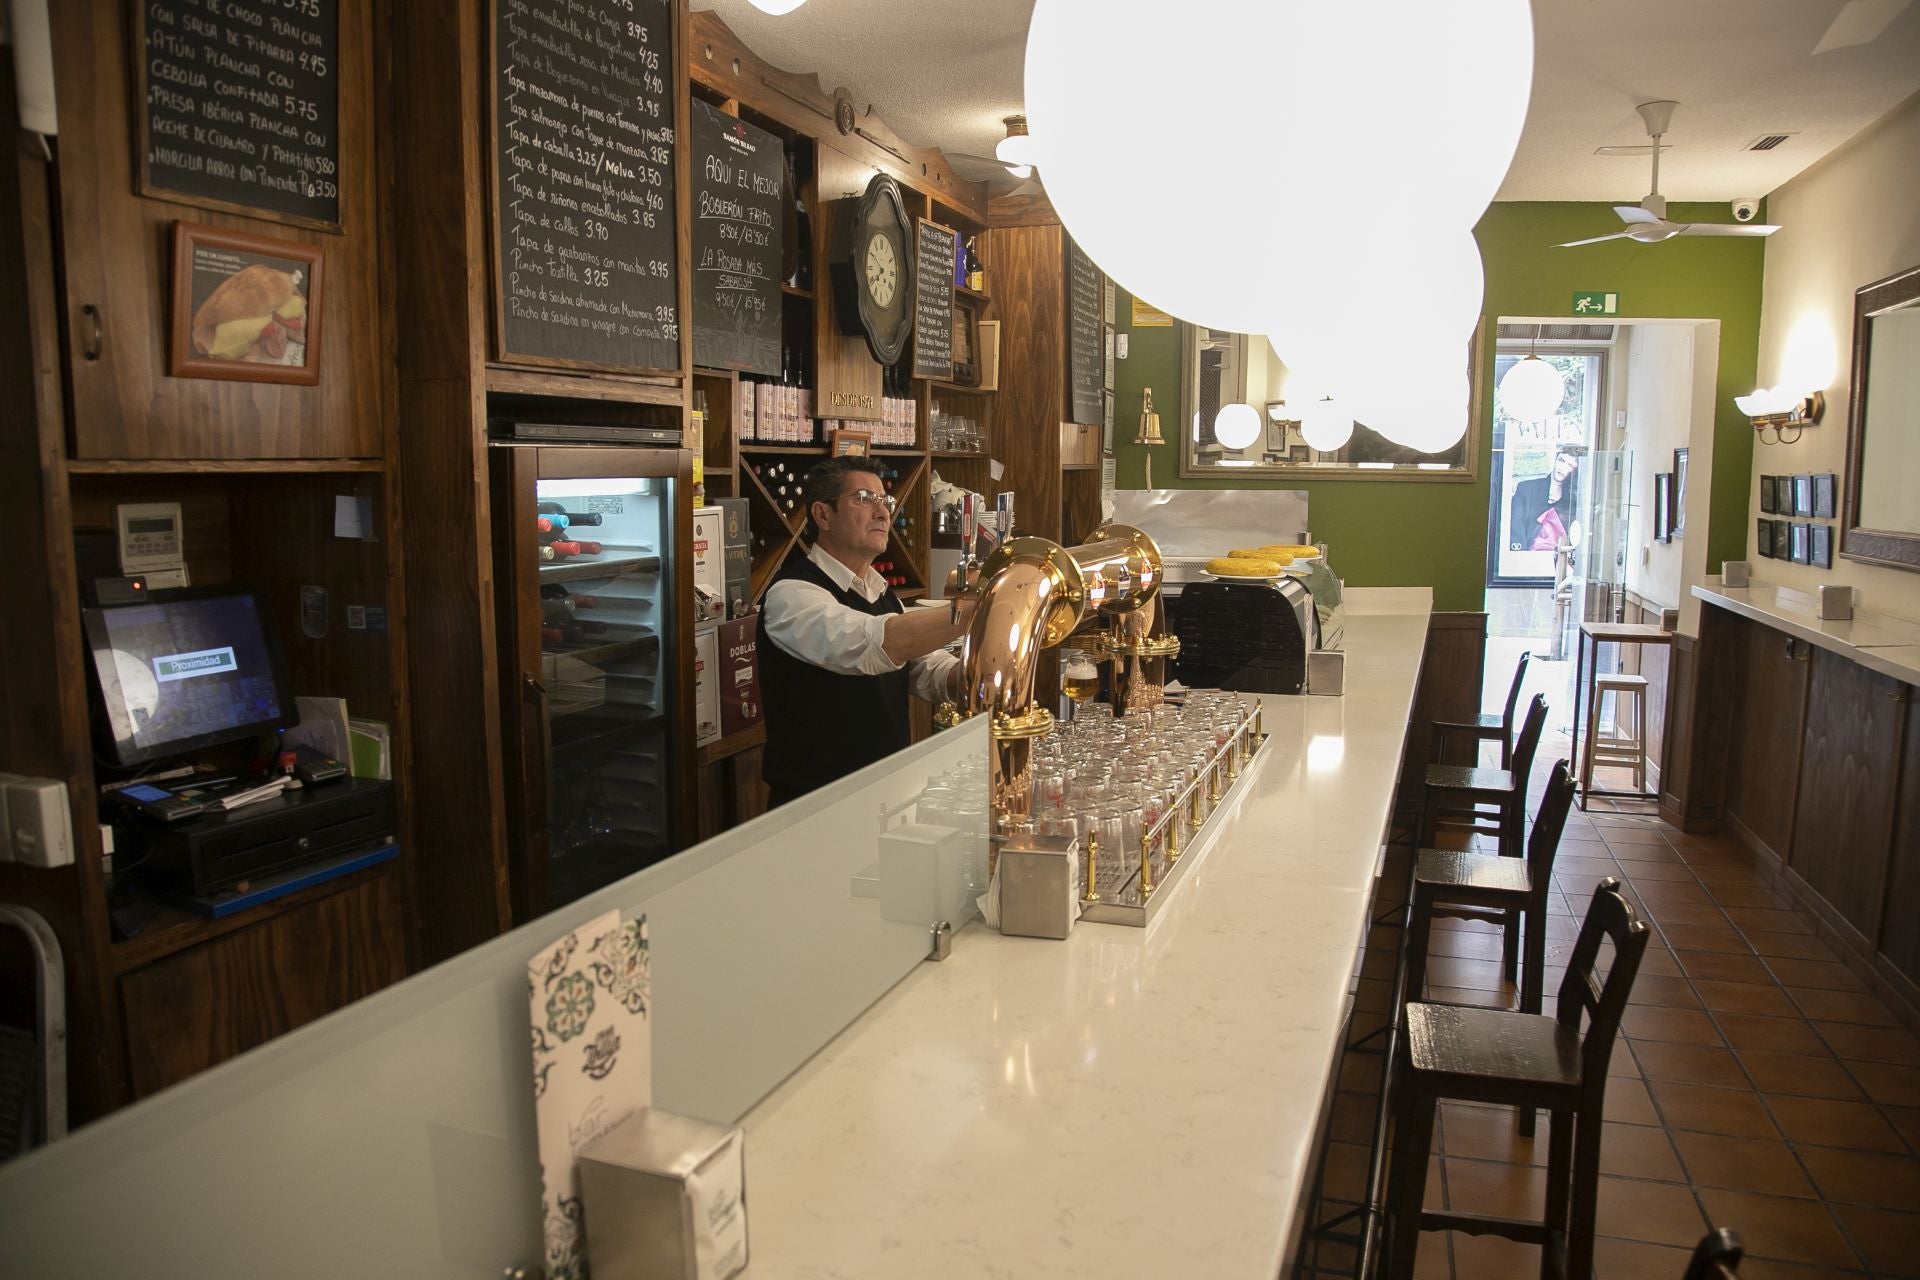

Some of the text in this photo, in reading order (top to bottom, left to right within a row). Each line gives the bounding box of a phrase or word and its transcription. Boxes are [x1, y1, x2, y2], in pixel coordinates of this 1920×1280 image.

[226, 3, 263, 27] CHOCO
[627, 21, 648, 43] 3.95
[151, 3, 174, 26] CON
[182, 14, 217, 40] SALSA
[299, 51, 327, 77] 4.95
[152, 28, 294, 89] ATÚN PLANCHA CON
[504, 12, 528, 41] Tapa
[644, 70, 663, 94] 4.40
[151, 59, 207, 89] CEBOLLA
[285, 95, 318, 121] 5.75
[504, 64, 527, 94] Tapa
[571, 94, 581, 113] de
[507, 40, 531, 69] Tapa
[637, 95, 659, 118] 3.95
[151, 84, 195, 113] PRESA
[249, 112, 299, 138] PLANCHA
[304, 130, 325, 148] CON
[504, 92, 528, 123] Tapa
[505, 120, 531, 148] Tapa
[532, 131, 542, 149] de
[605, 159, 636, 179] Melva
[638, 165, 662, 187] 3.50
[505, 145, 534, 174] Tapa
[537, 156, 549, 176] de
[551, 168, 572, 185] papas
[705, 154, 780, 200] AQUÍ EL MEJOR
[507, 173, 534, 200] Tapa
[537, 185, 547, 202] de
[632, 208, 656, 229] 3.85
[509, 199, 537, 228] Tapa
[540, 213, 553, 229] de
[584, 219, 609, 241] 3.90
[510, 247, 544, 275] Pincho
[583, 267, 609, 288] 3.25
[511, 224, 540, 252] Tapa
[543, 238, 555, 255] de
[649, 260, 669, 279] 3.95
[701, 246, 714, 266] LA
[717, 249, 742, 271] ROSADA
[508, 271, 537, 301] Pincho
[538, 283, 549, 302] de
[719, 274, 753, 288] SABROSA
[508, 296, 539, 320] Pincho
[540, 306, 549, 322] de
[580, 316, 591, 328] en
[830, 391, 856, 407] DESDE
[170, 655, 221, 672] Proximidad
[729, 642, 756, 658] DOBLAS
